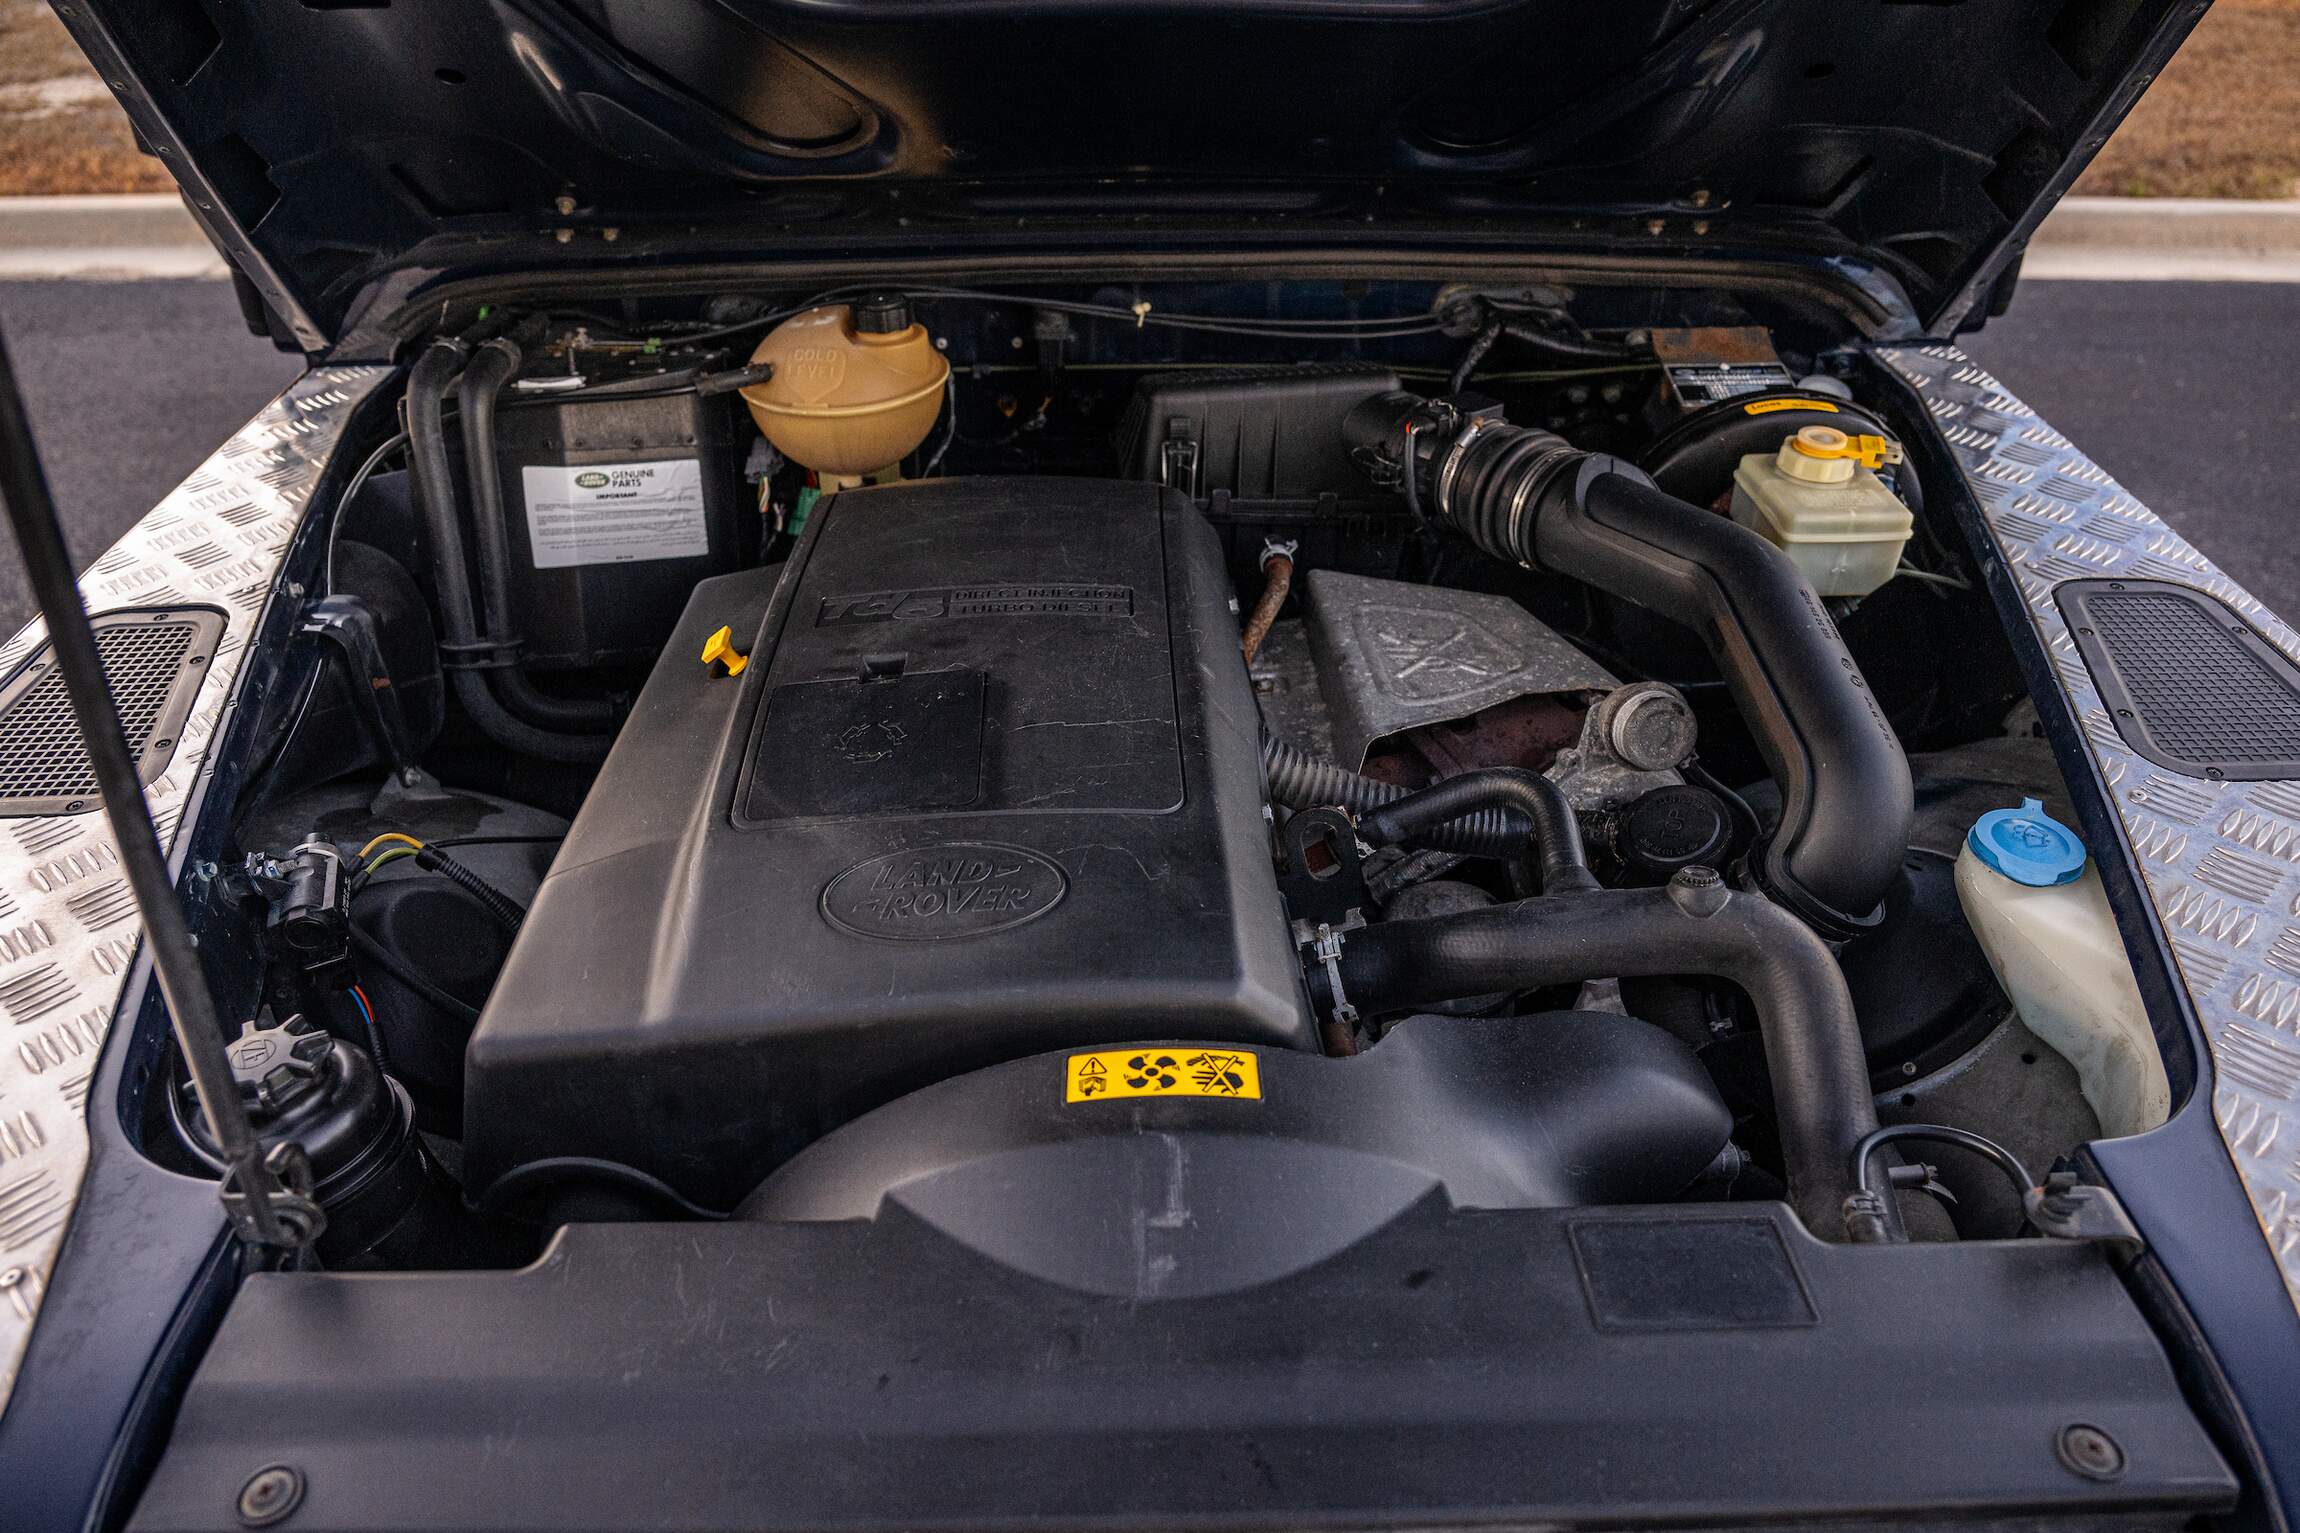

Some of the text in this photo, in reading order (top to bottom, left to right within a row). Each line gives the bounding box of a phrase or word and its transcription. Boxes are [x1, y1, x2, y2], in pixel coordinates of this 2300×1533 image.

[793, 349, 836, 361] COLD
[611, 469, 655, 480] GENUINE
[612, 479, 641, 487] PARTS
[955, 588, 1126, 599] DIRECT INJECTION
[961, 602, 1118, 614] TURBO DIESEL
